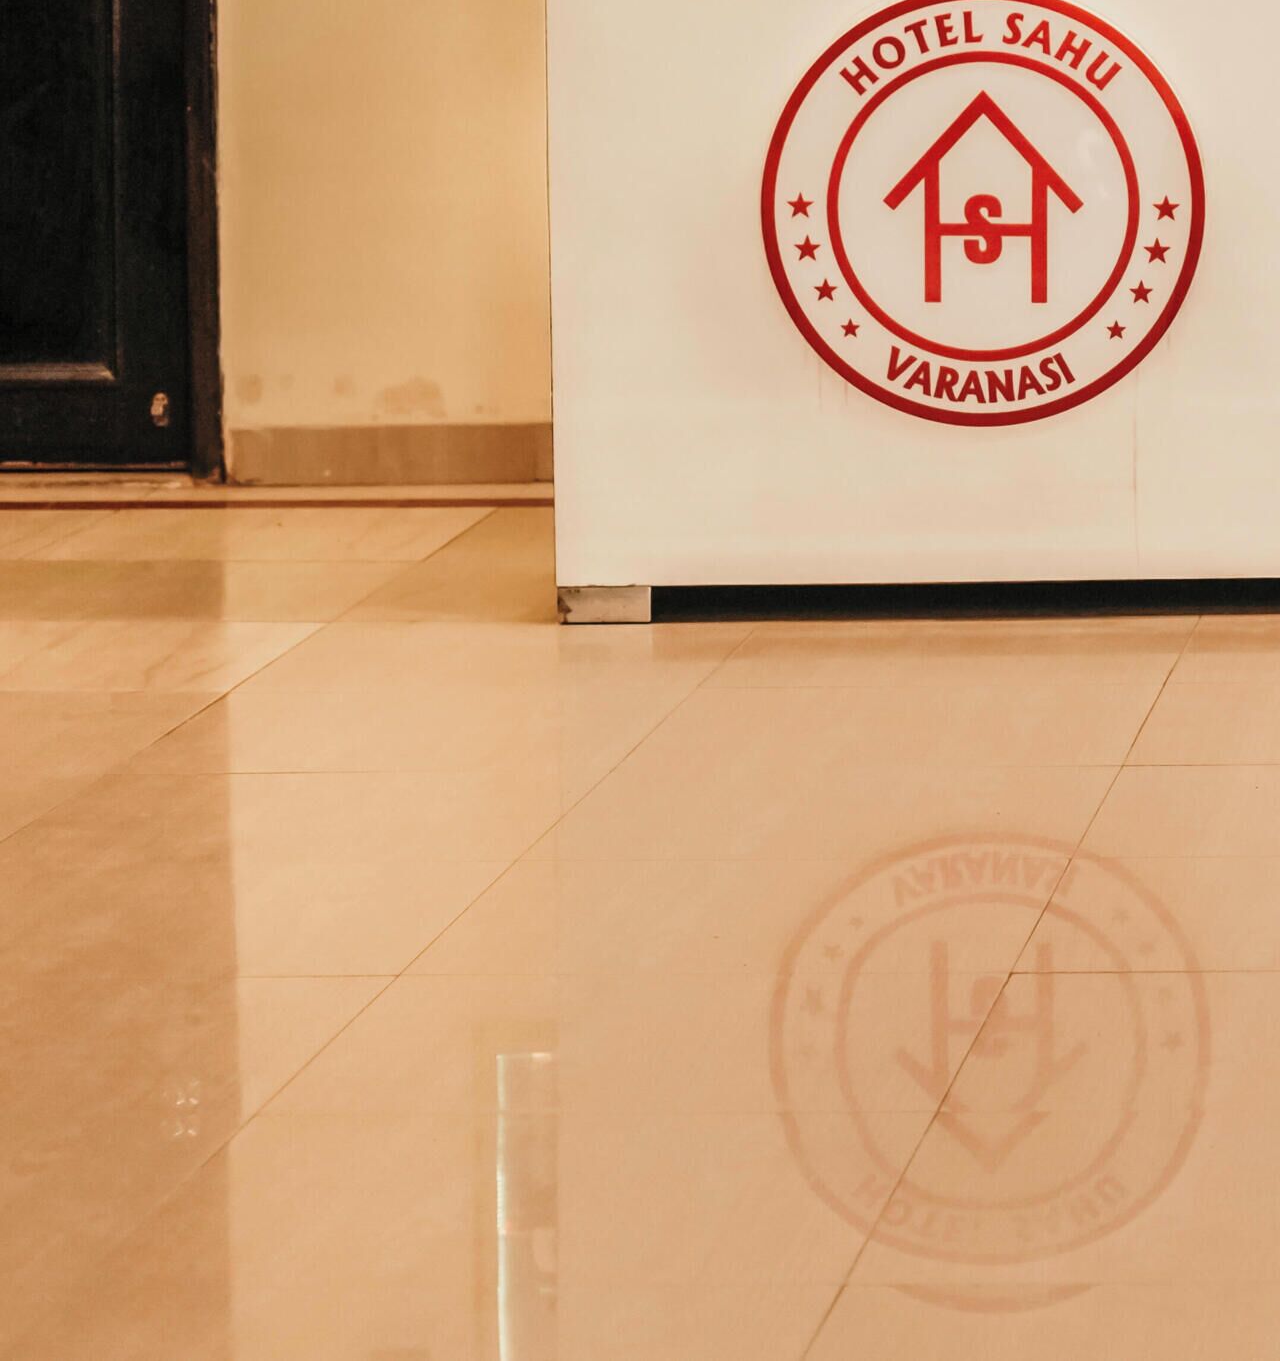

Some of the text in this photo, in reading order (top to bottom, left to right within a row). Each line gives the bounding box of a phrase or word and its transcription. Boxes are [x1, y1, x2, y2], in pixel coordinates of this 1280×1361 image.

[838, 9, 1123, 97] HOTEL SAHU
[885, 343, 1077, 406] VARANASI
